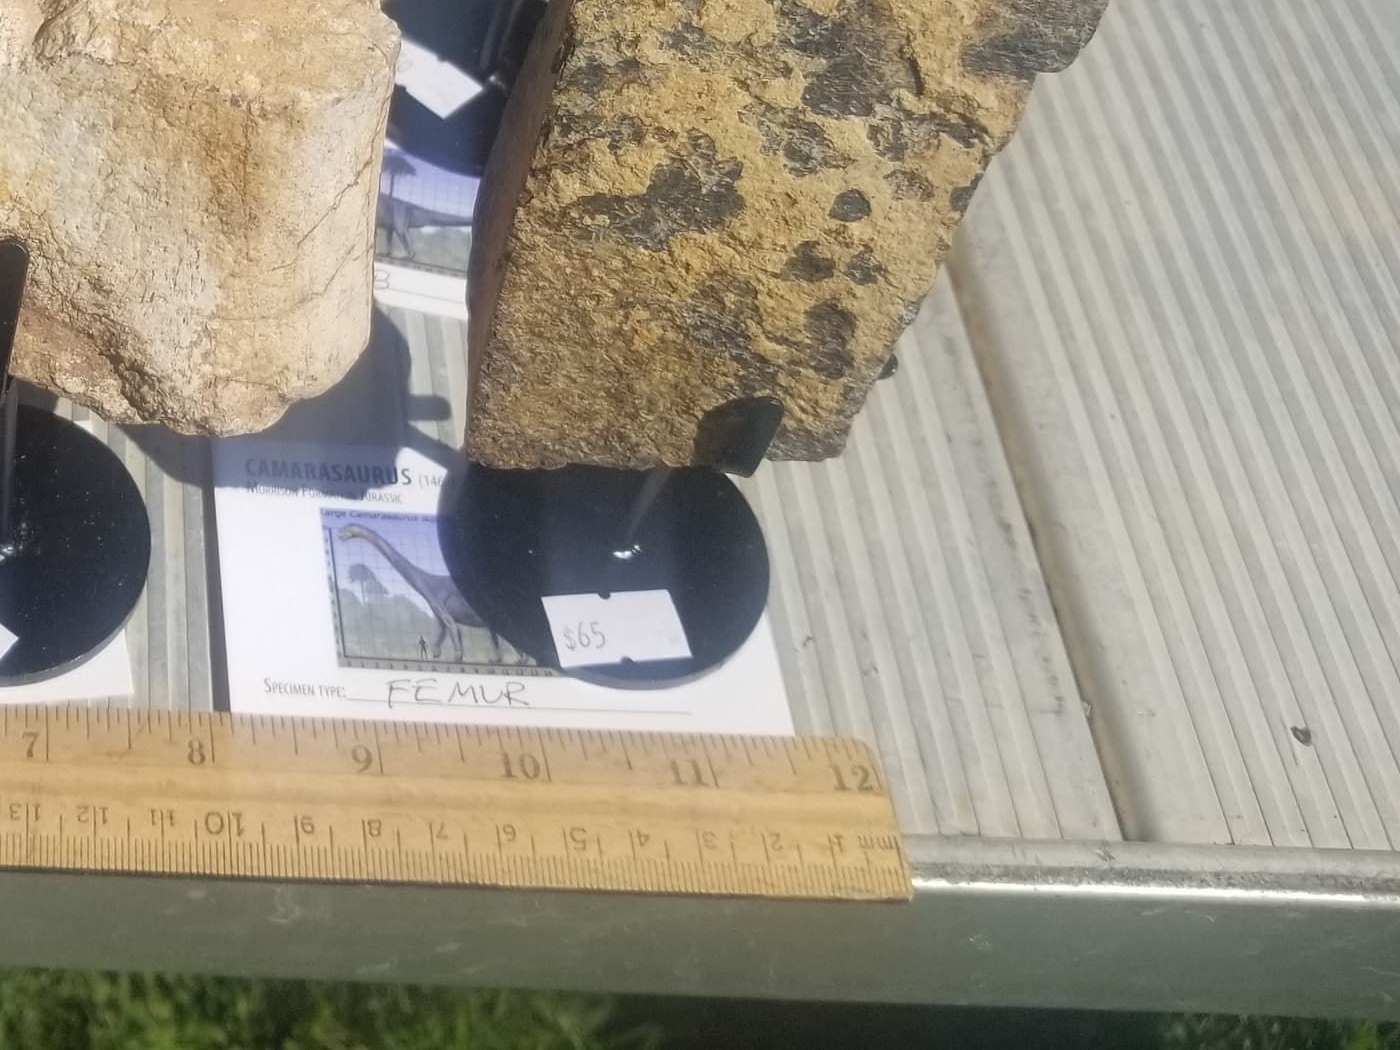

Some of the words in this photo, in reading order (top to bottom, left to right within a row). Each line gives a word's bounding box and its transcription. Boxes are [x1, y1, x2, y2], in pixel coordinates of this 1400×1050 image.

[244, 457, 412, 486] CAMARASAURUS
[563, 621, 607, 651] $65
[263, 677, 316, 697] SPECIMEN
[386, 677, 530, 709] FEMUR
[21, 731, 40, 759] 7
[187, 738, 207, 766] 8
[351, 744, 373, 774] 9
[501, 751, 541, 780] 10
[669, 758, 709, 787] 11
[830, 763, 874, 791] 12
[8, 803, 41, 822] 13
[76, 805, 109, 825] 12
[149, 807, 176, 827] 11
[204, 810, 246, 836] 10
[300, 815, 316, 835] 9
[367, 819, 383, 838] 8
[436, 821, 449, 841] 7
[502, 823, 517, 842] 6
[569, 826, 587, 851] 5
[636, 829, 650, 847] 4
[701, 830, 716, 849] 3
[769, 832, 783, 852] 2
[834, 833, 845, 853] 1
[856, 835, 897, 851] mm
